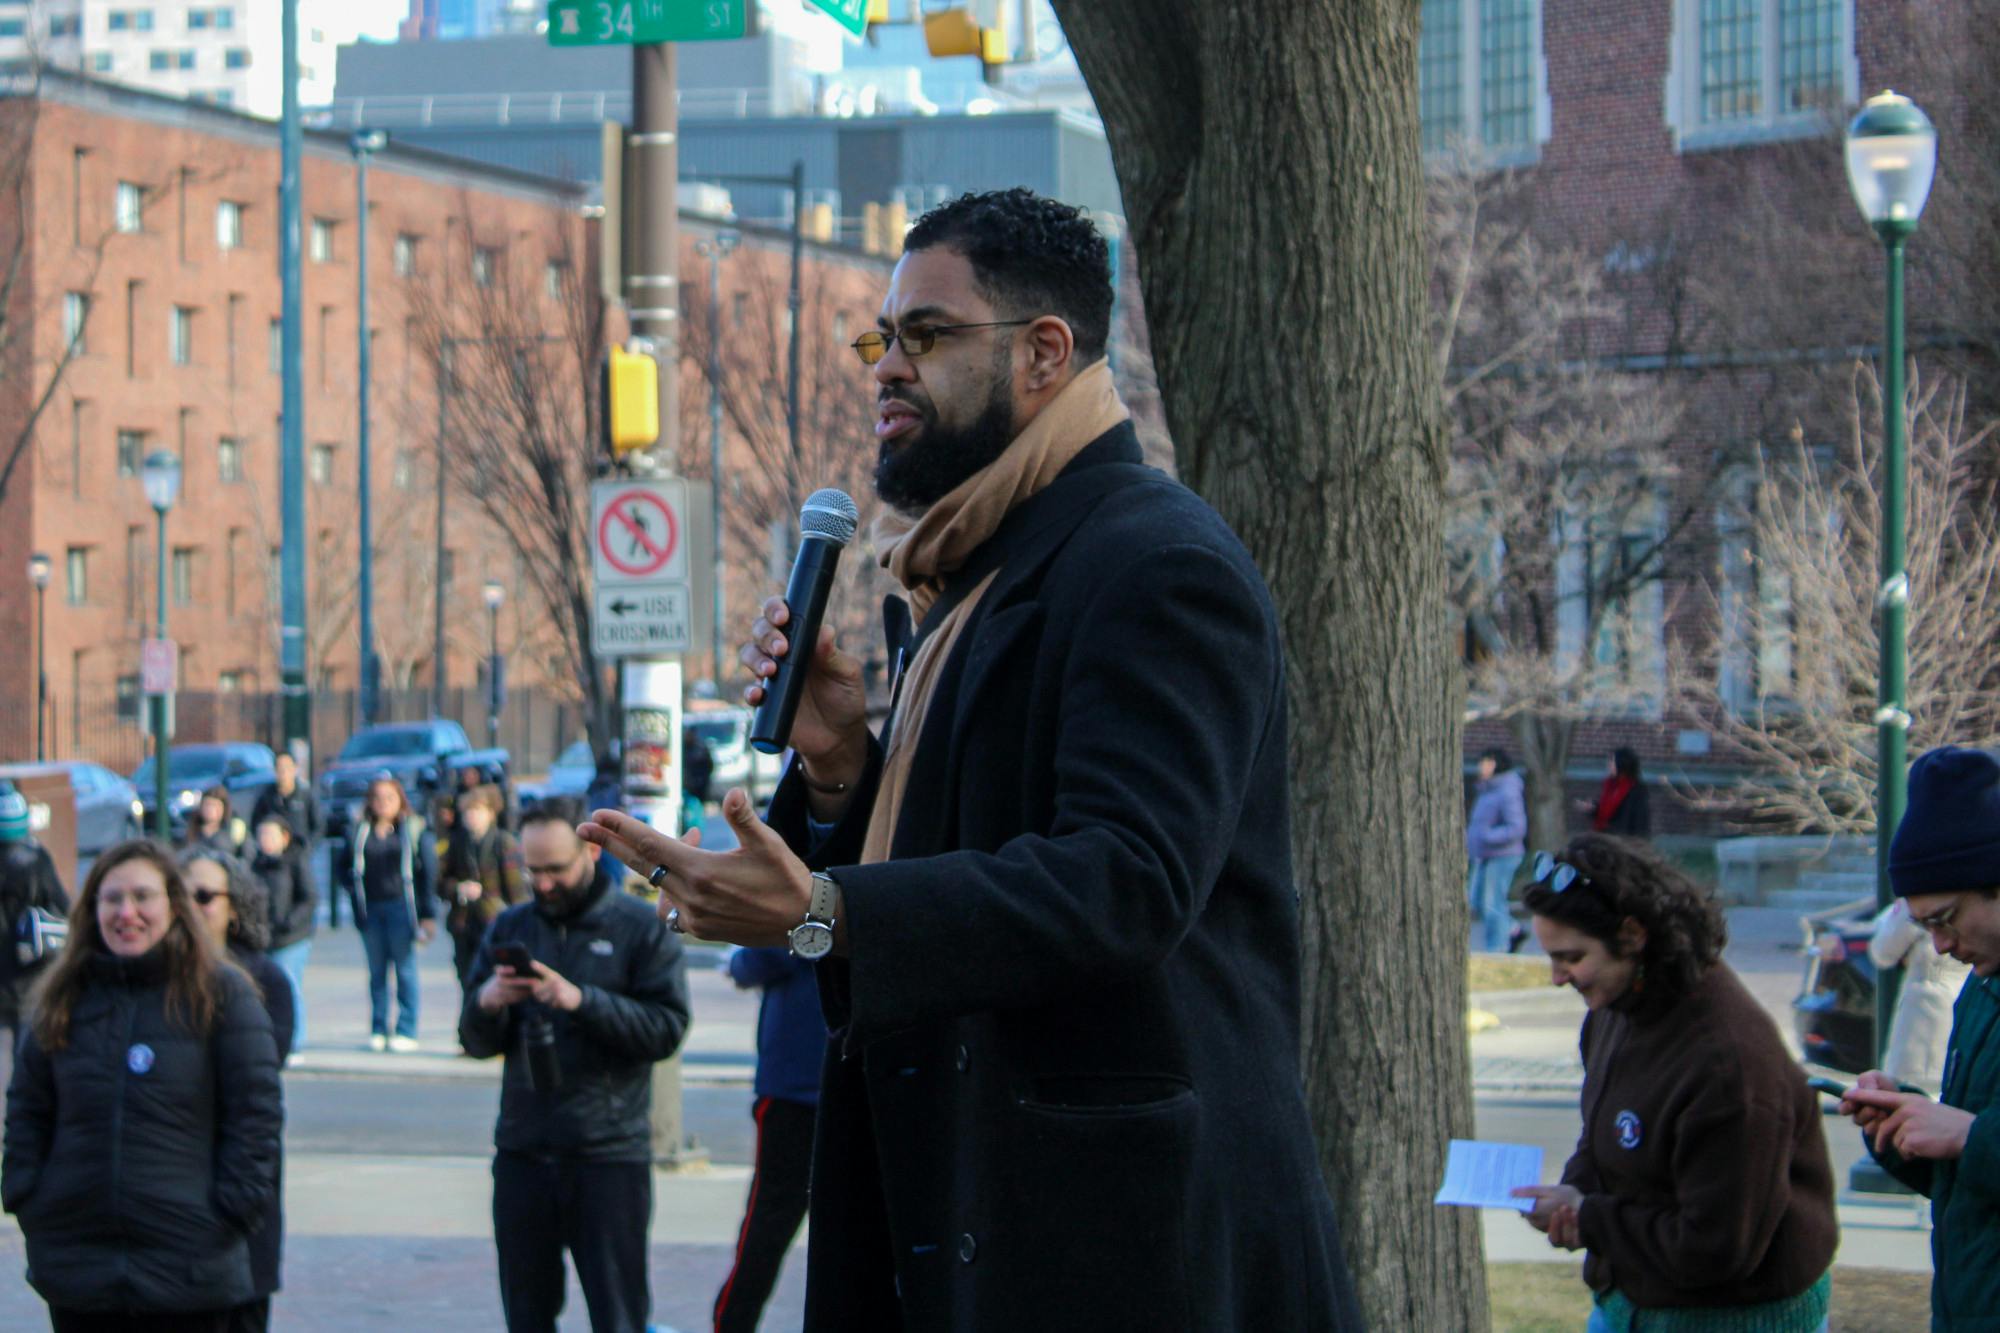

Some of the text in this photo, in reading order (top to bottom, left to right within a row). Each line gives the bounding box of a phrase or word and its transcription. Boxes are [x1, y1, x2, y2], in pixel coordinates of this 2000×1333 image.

[708, 2, 731, 28] ST
[643, 597, 676, 616] USE
[600, 623, 686, 642] CROSSWALK
